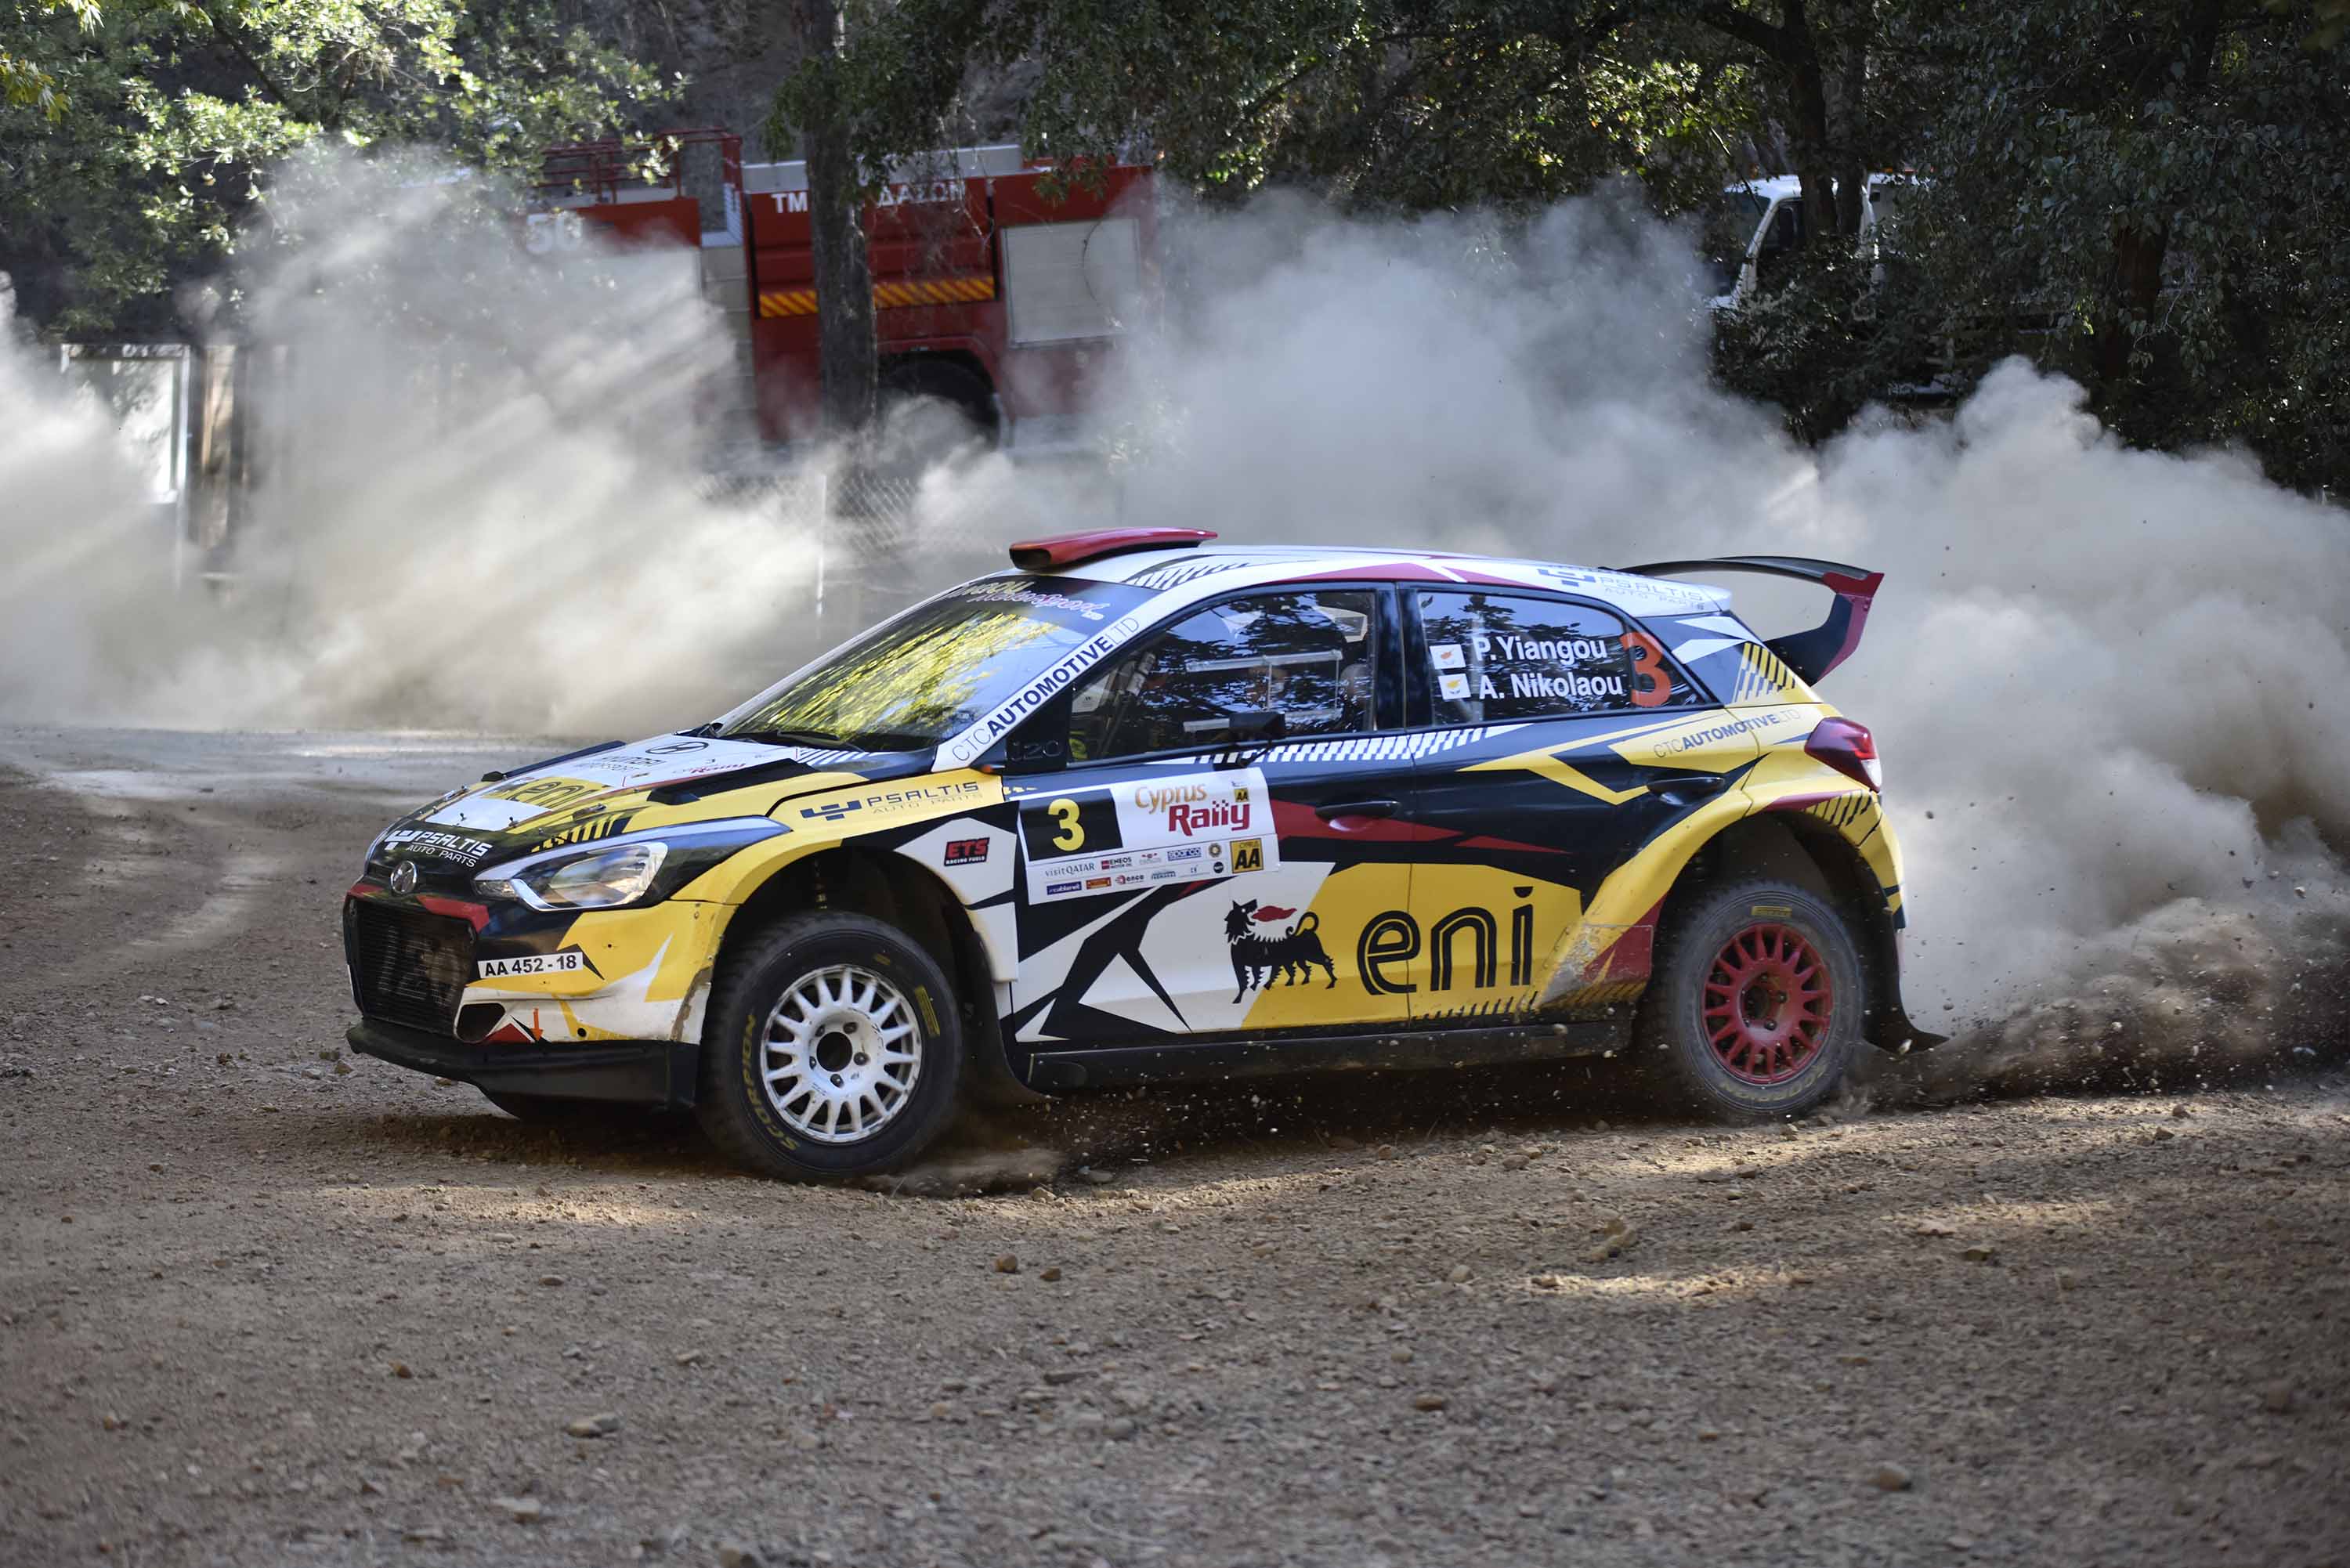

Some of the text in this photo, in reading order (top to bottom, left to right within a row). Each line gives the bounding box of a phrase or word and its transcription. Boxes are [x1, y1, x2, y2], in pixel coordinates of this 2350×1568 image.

[1619, 631, 1672, 708] 3
[1479, 671, 1623, 700] A. Nikolaou
[866, 781, 979, 807] PSALTIS
[1135, 783, 1208, 815] Cyprus
[1047, 798, 1086, 852] 3
[1168, 799, 1251, 836] Rally
[405, 844, 478, 869] AUTO PARTS
[414, 830, 493, 858] PSALTIS
[948, 839, 988, 858] ETS
[1234, 847, 1261, 871] AA
[1357, 886, 1534, 995] eni
[485, 961, 508, 977] AA
